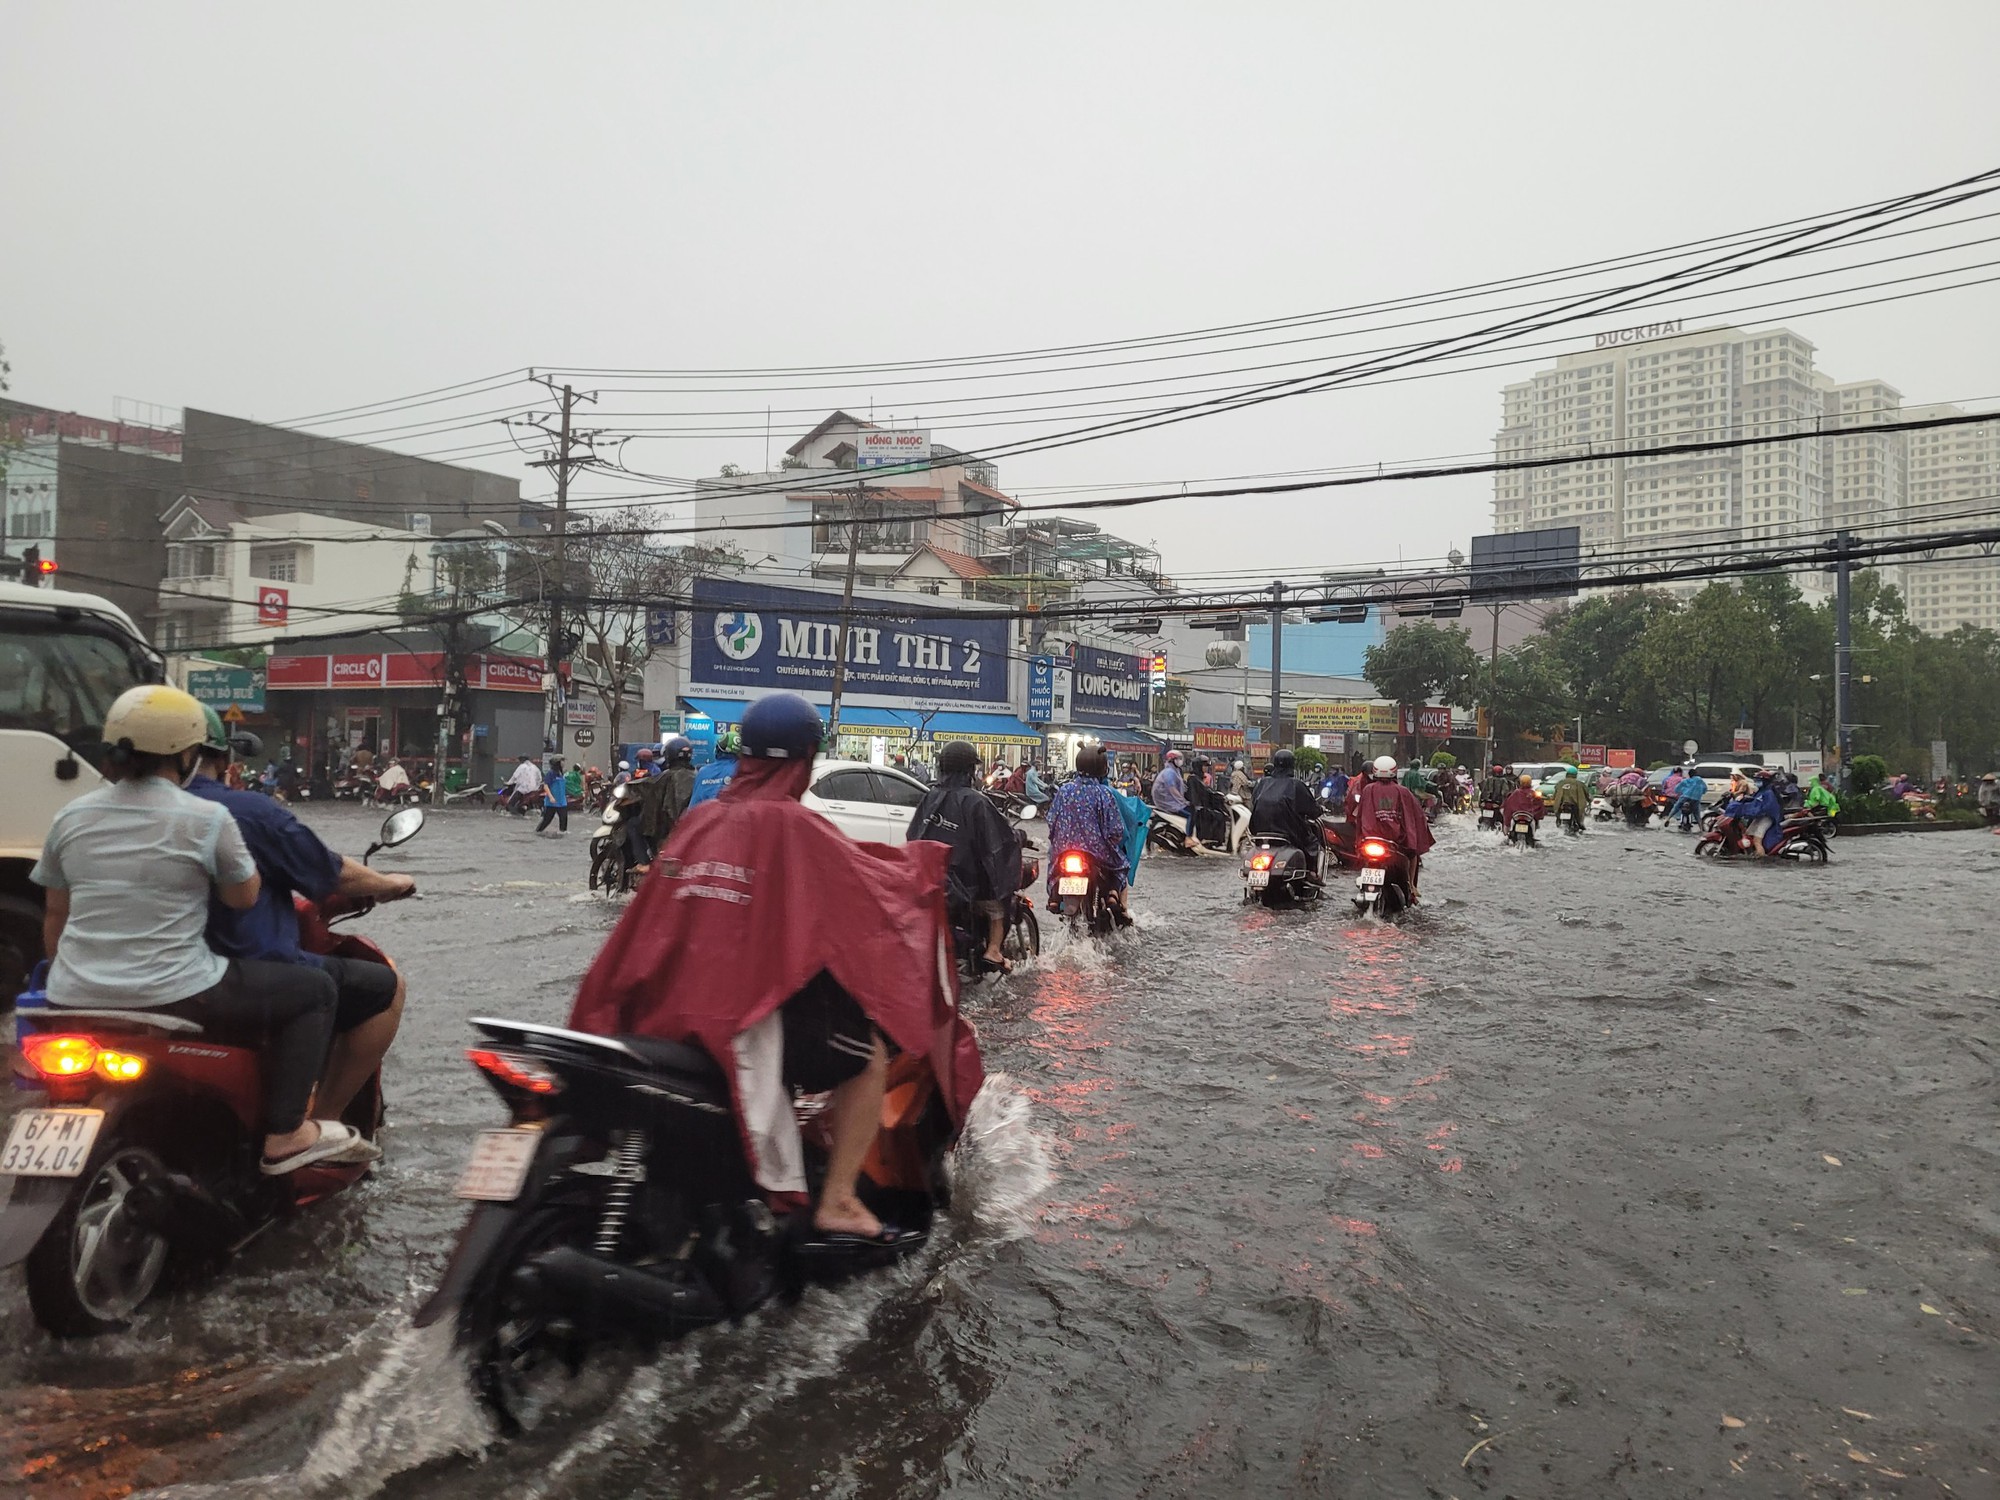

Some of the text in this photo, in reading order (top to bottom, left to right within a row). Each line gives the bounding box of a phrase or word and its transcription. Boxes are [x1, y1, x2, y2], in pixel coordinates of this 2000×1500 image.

[896, 436, 923, 446] NGỌC
[962, 639, 981, 674] 2
[333, 659, 380, 678] CIRCLE K
[489, 664, 525, 678] CIRCLE
[1035, 676, 1047, 684] NHÀ
[1032, 686, 1051, 694] THUỐC
[1077, 672, 1110, 697] LONG
[1110, 674, 1140, 702] CHÂU
[1031, 698, 1050, 707] MINH
[1045, 710, 1050, 718] 2
[938, 732, 954, 741] TÍCH
[1026, 737, 1038, 745] TỐT
[1196, 729, 1206, 746] HỦ
[1207, 729, 1222, 747] TIẾU
[1222, 734, 1231, 747] SA
[3, 1144, 83, 1171] 334.04
